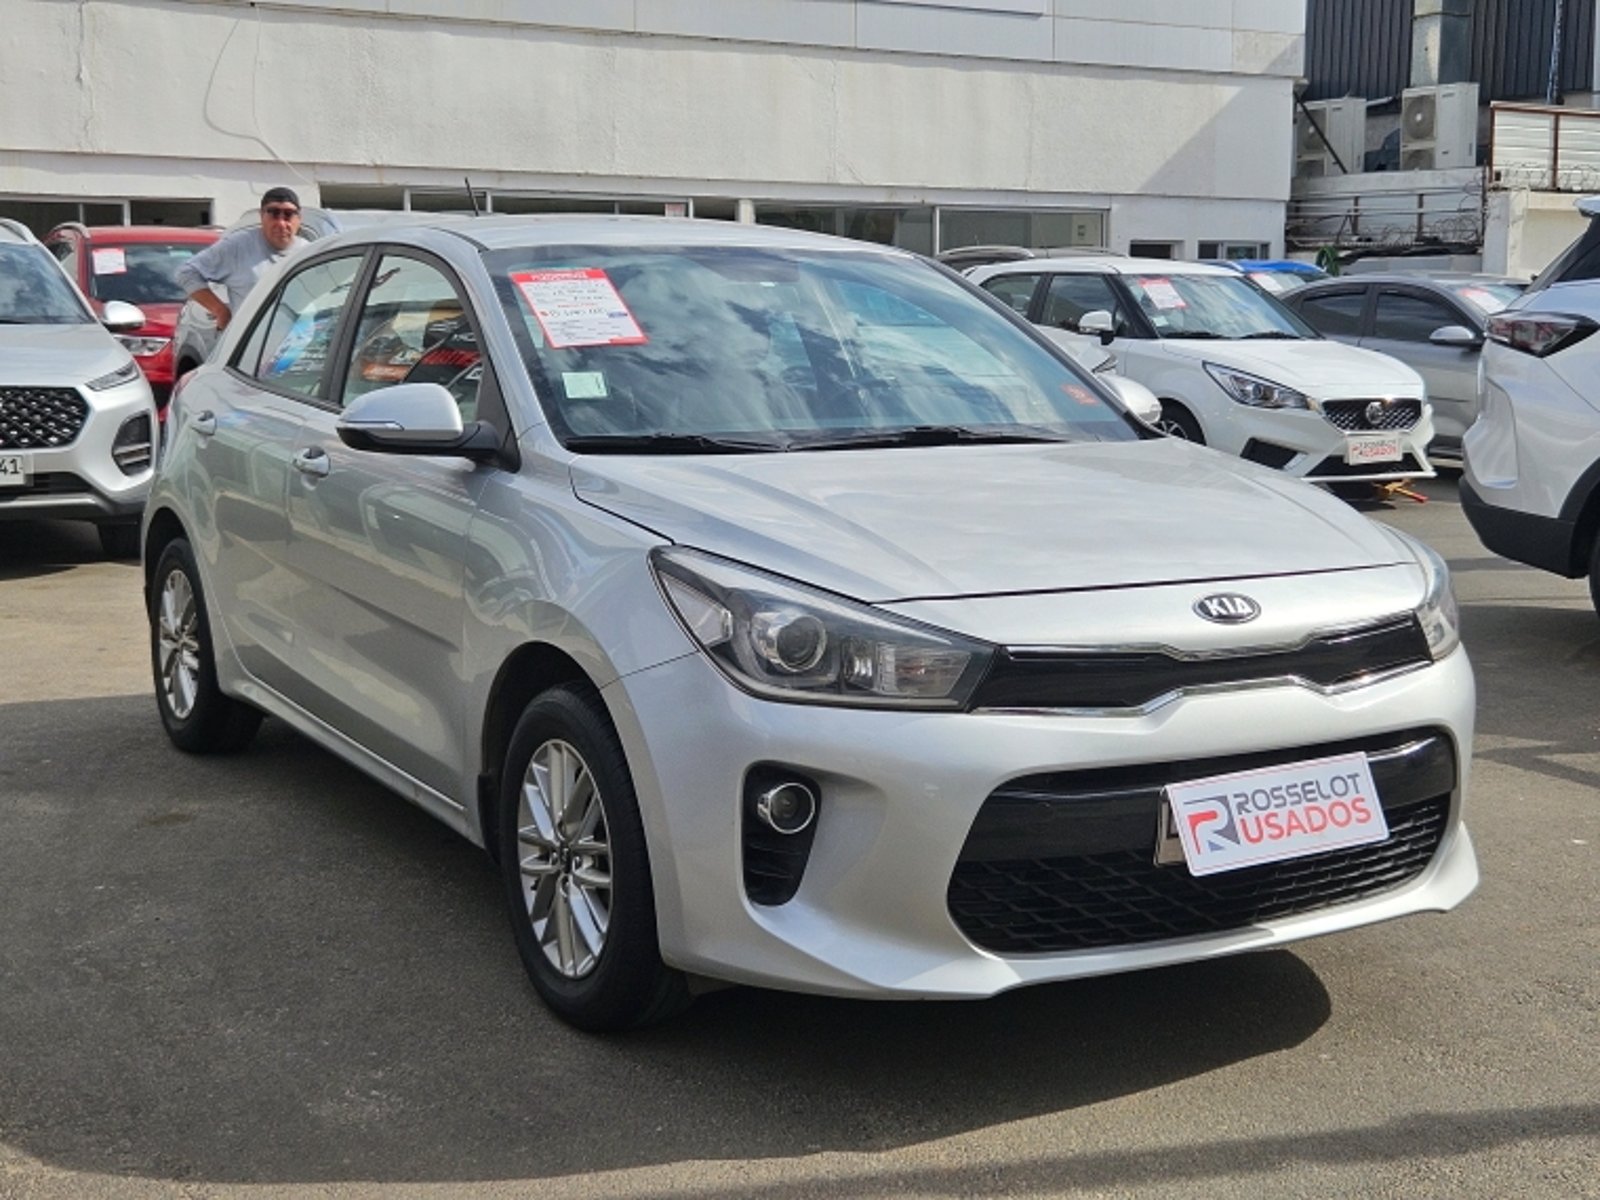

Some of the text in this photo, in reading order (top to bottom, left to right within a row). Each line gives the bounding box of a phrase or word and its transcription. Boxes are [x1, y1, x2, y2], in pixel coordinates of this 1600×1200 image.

[1203, 597, 1253, 616] KIA
[1233, 773, 1361, 815] ROSSELOT
[1240, 797, 1372, 843] USADOS
